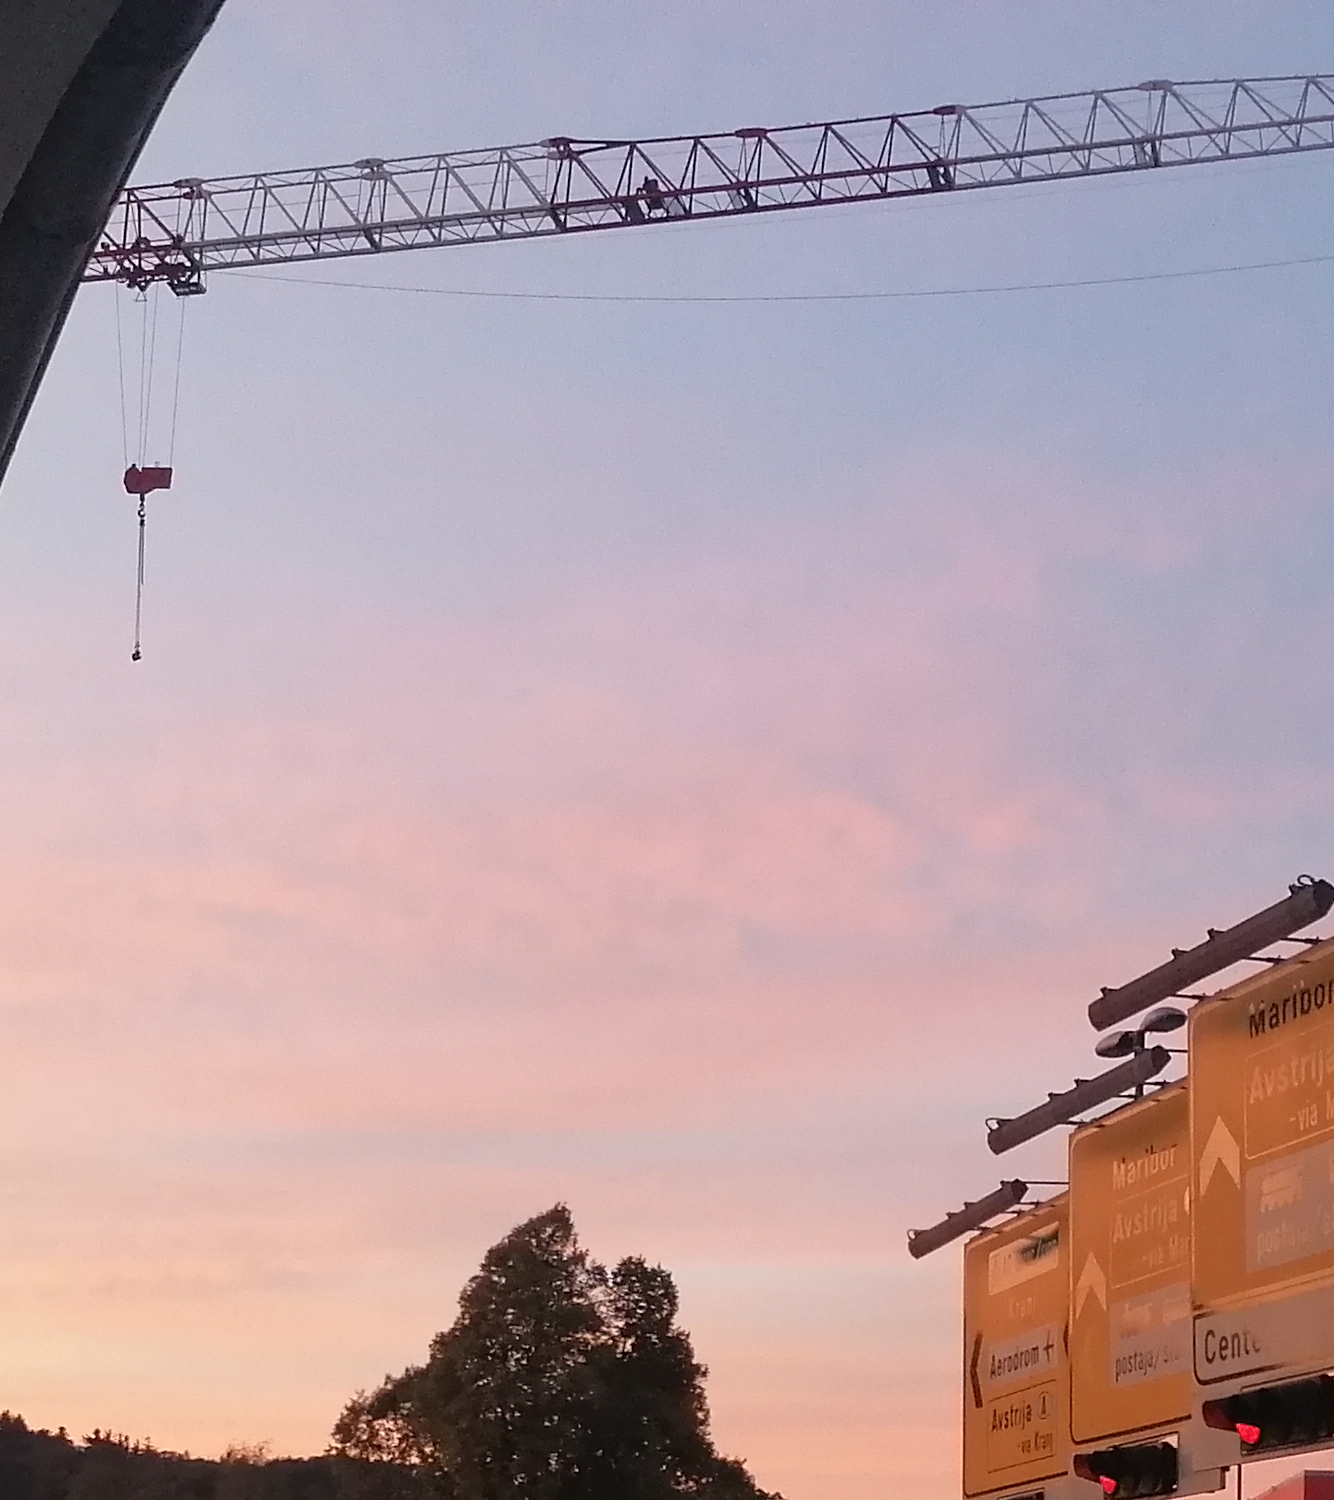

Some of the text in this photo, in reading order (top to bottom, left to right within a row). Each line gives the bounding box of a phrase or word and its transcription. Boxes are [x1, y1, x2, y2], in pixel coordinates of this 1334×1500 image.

[1112, 1143, 1178, 1191] Maribor
[1113, 1200, 1178, 1244] Avstrija
[989, 1344, 1041, 1379] Aerodrom
[991, 1400, 1033, 1432] Avstrija
